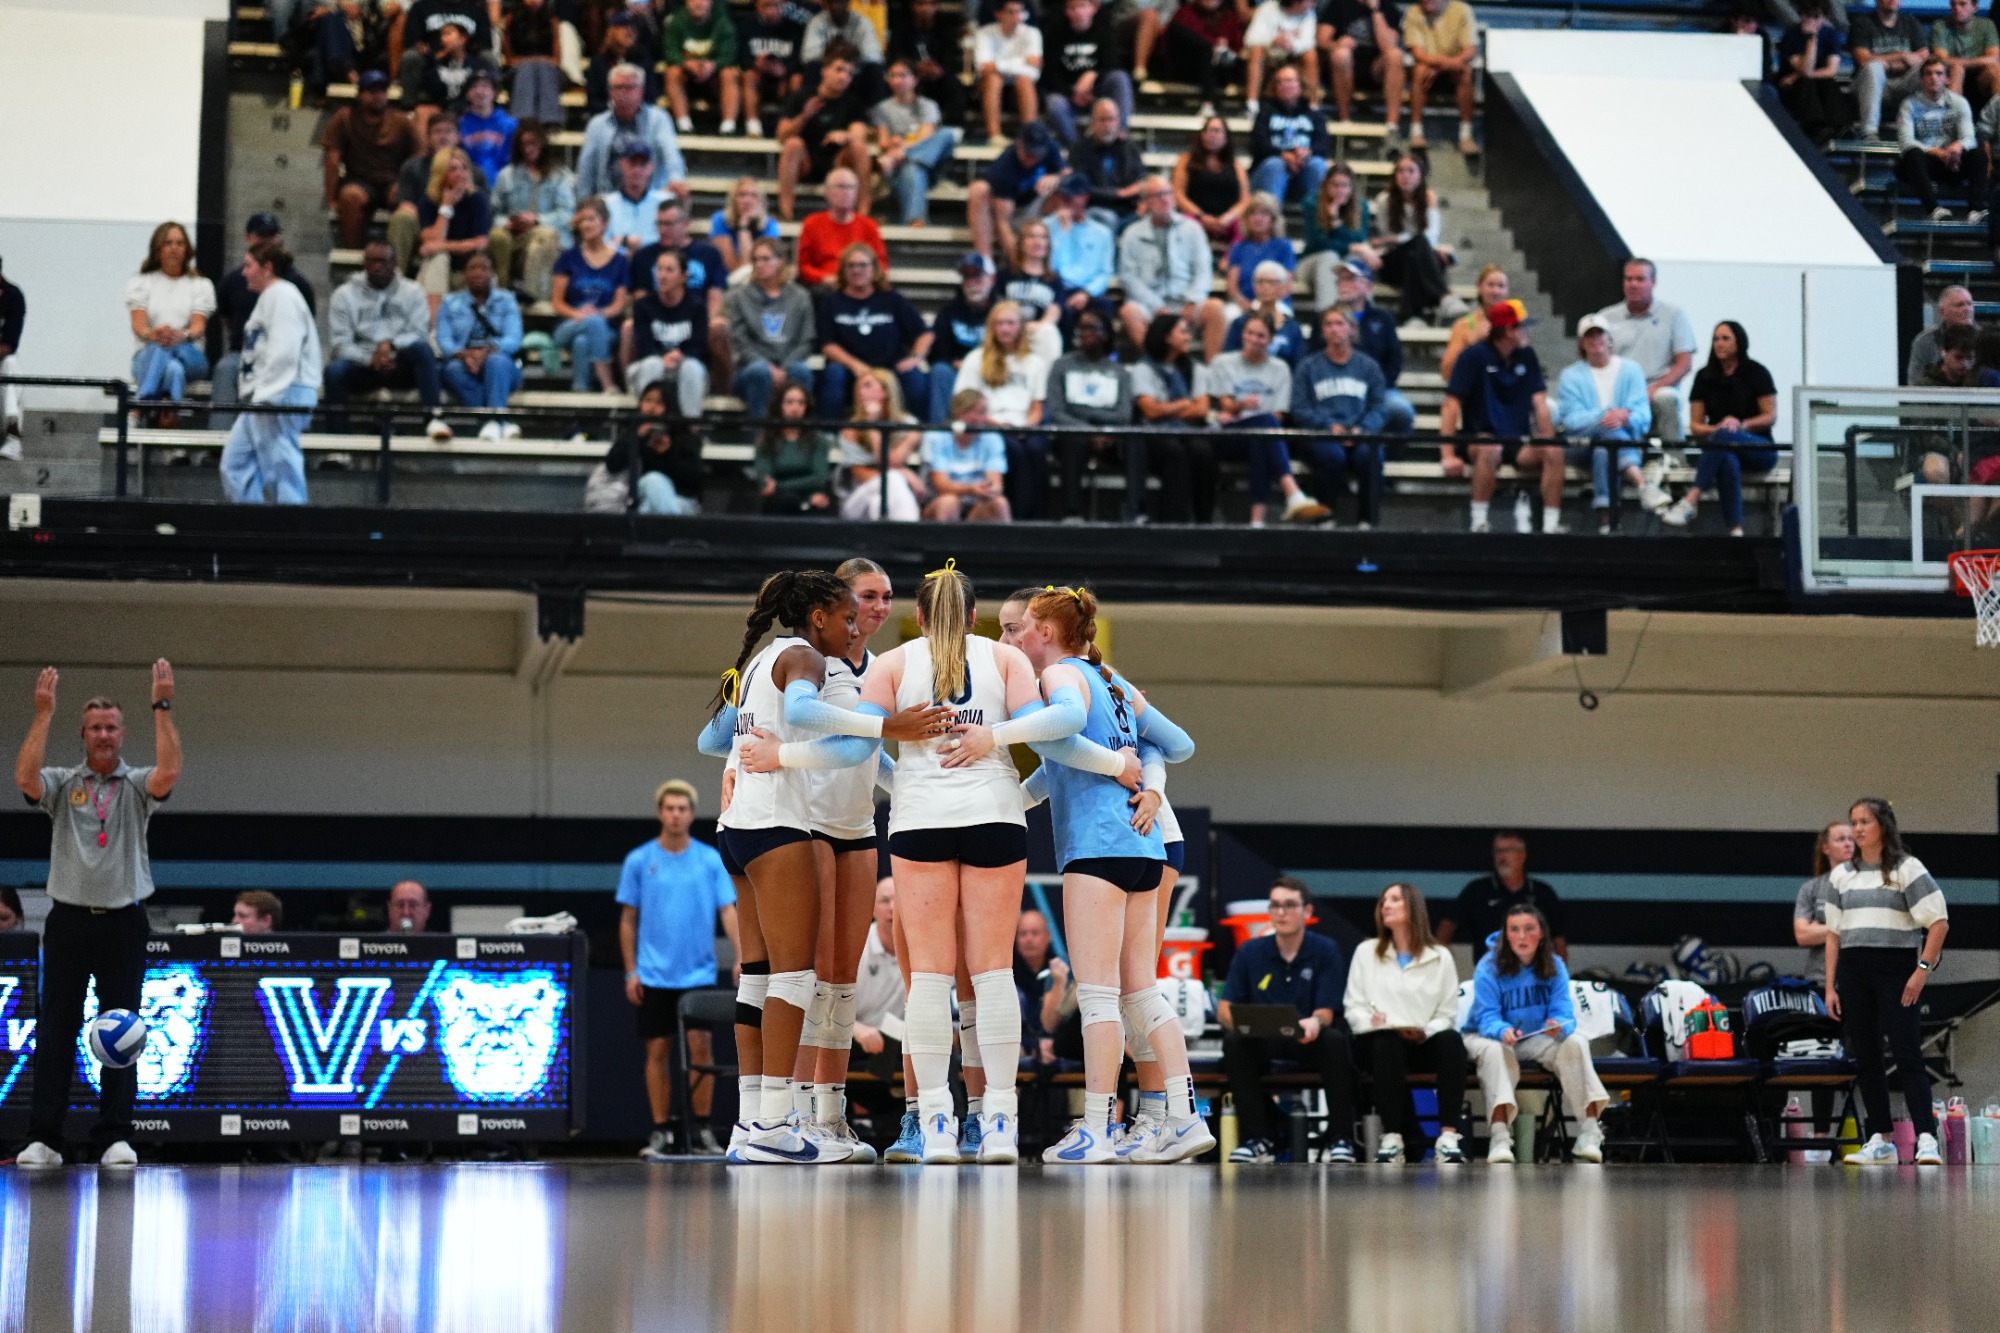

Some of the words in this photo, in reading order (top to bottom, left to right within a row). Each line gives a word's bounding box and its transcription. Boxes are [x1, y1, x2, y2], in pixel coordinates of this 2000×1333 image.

[1107, 686, 1131, 734] 8
[243, 942, 290, 954] TOYOTA
[362, 943, 408, 955] TOYOTA
[479, 943, 525, 954] TOYOTA
[1753, 989, 1816, 1015] VILLANOVA
[258, 977, 392, 1094] V
[379, 1018, 428, 1052] VS
[244, 1119, 291, 1131] TOYOTA
[363, 1119, 409, 1131] TOYOTA
[480, 1118, 526, 1130] TOYOTA
